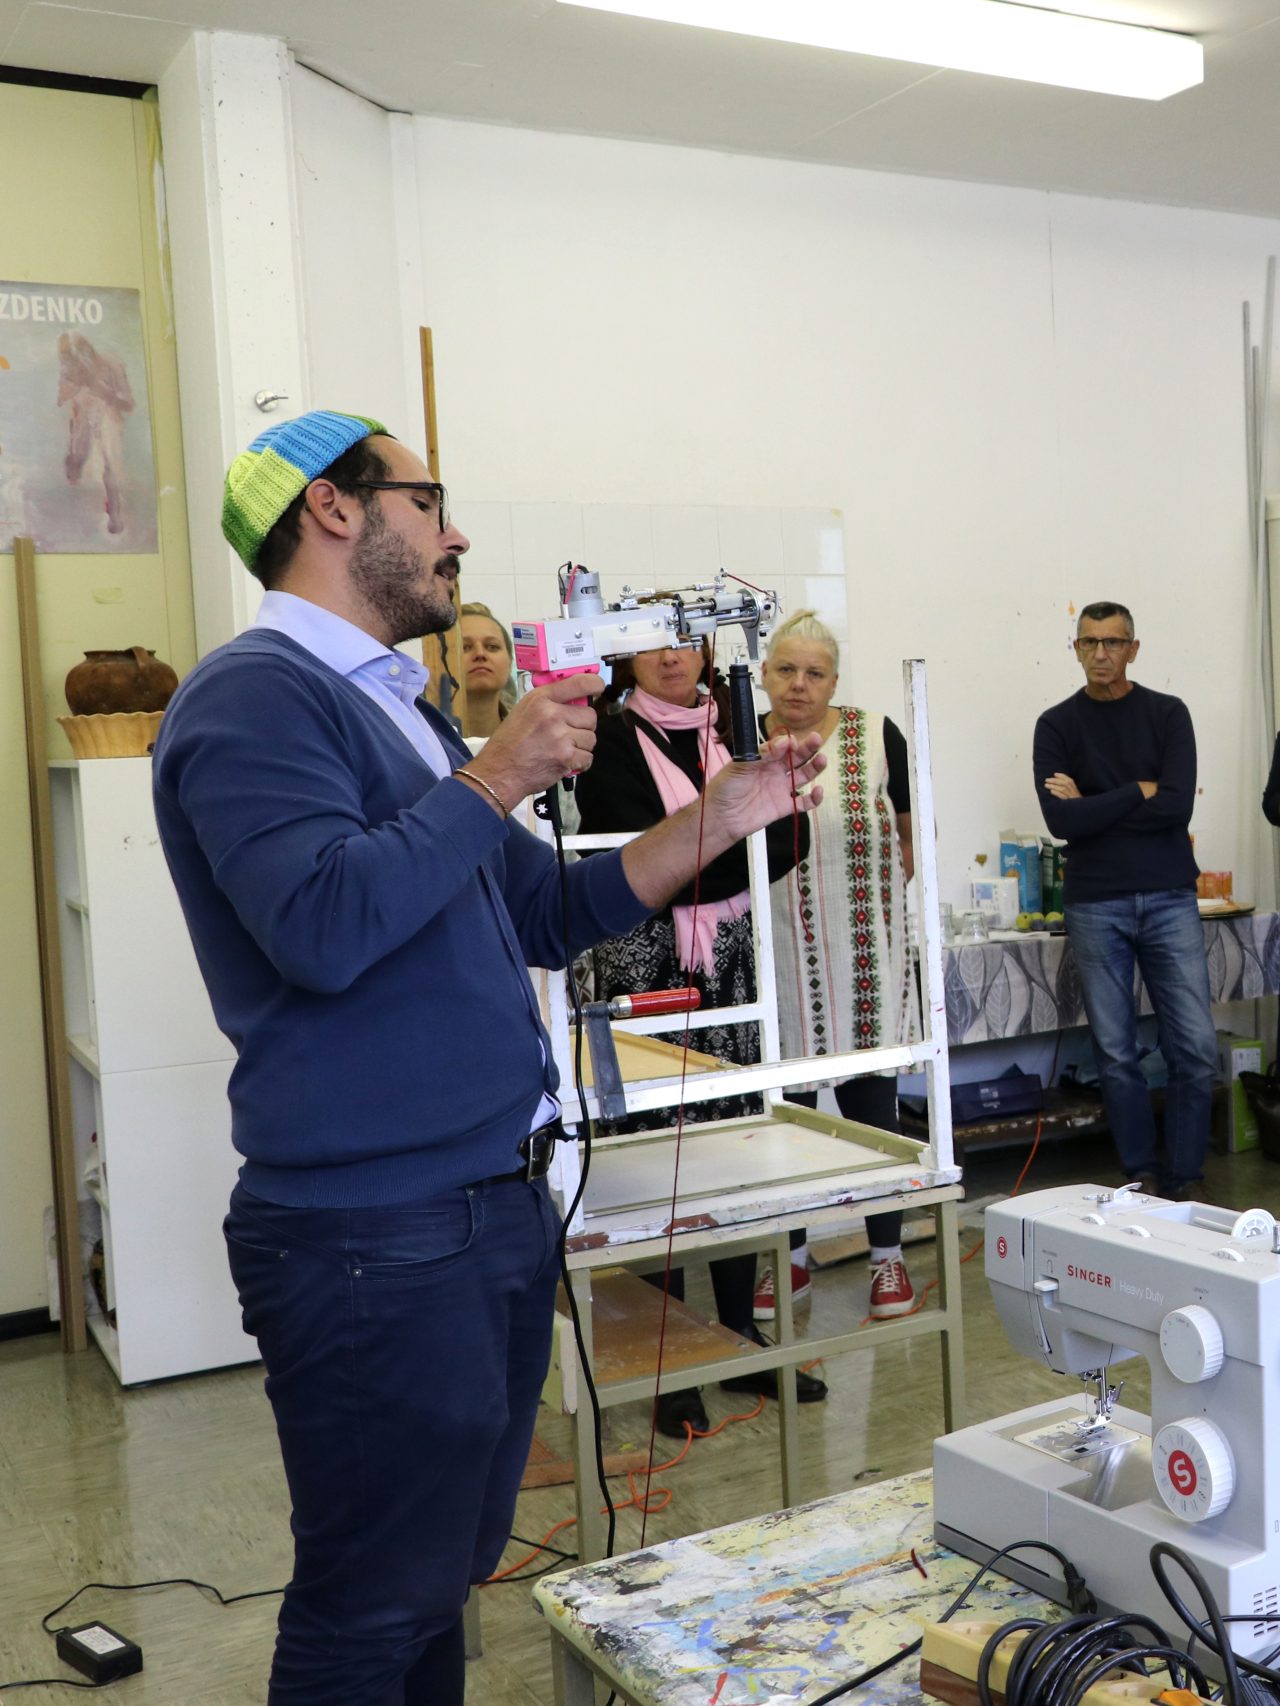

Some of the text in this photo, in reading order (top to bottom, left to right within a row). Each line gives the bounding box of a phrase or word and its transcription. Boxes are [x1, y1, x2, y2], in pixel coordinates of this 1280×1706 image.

[0, 292, 104, 325] ZDENKO
[1068, 1264, 1164, 1305] SINGER Heavy Duty
[1173, 1458, 1192, 1488] S
